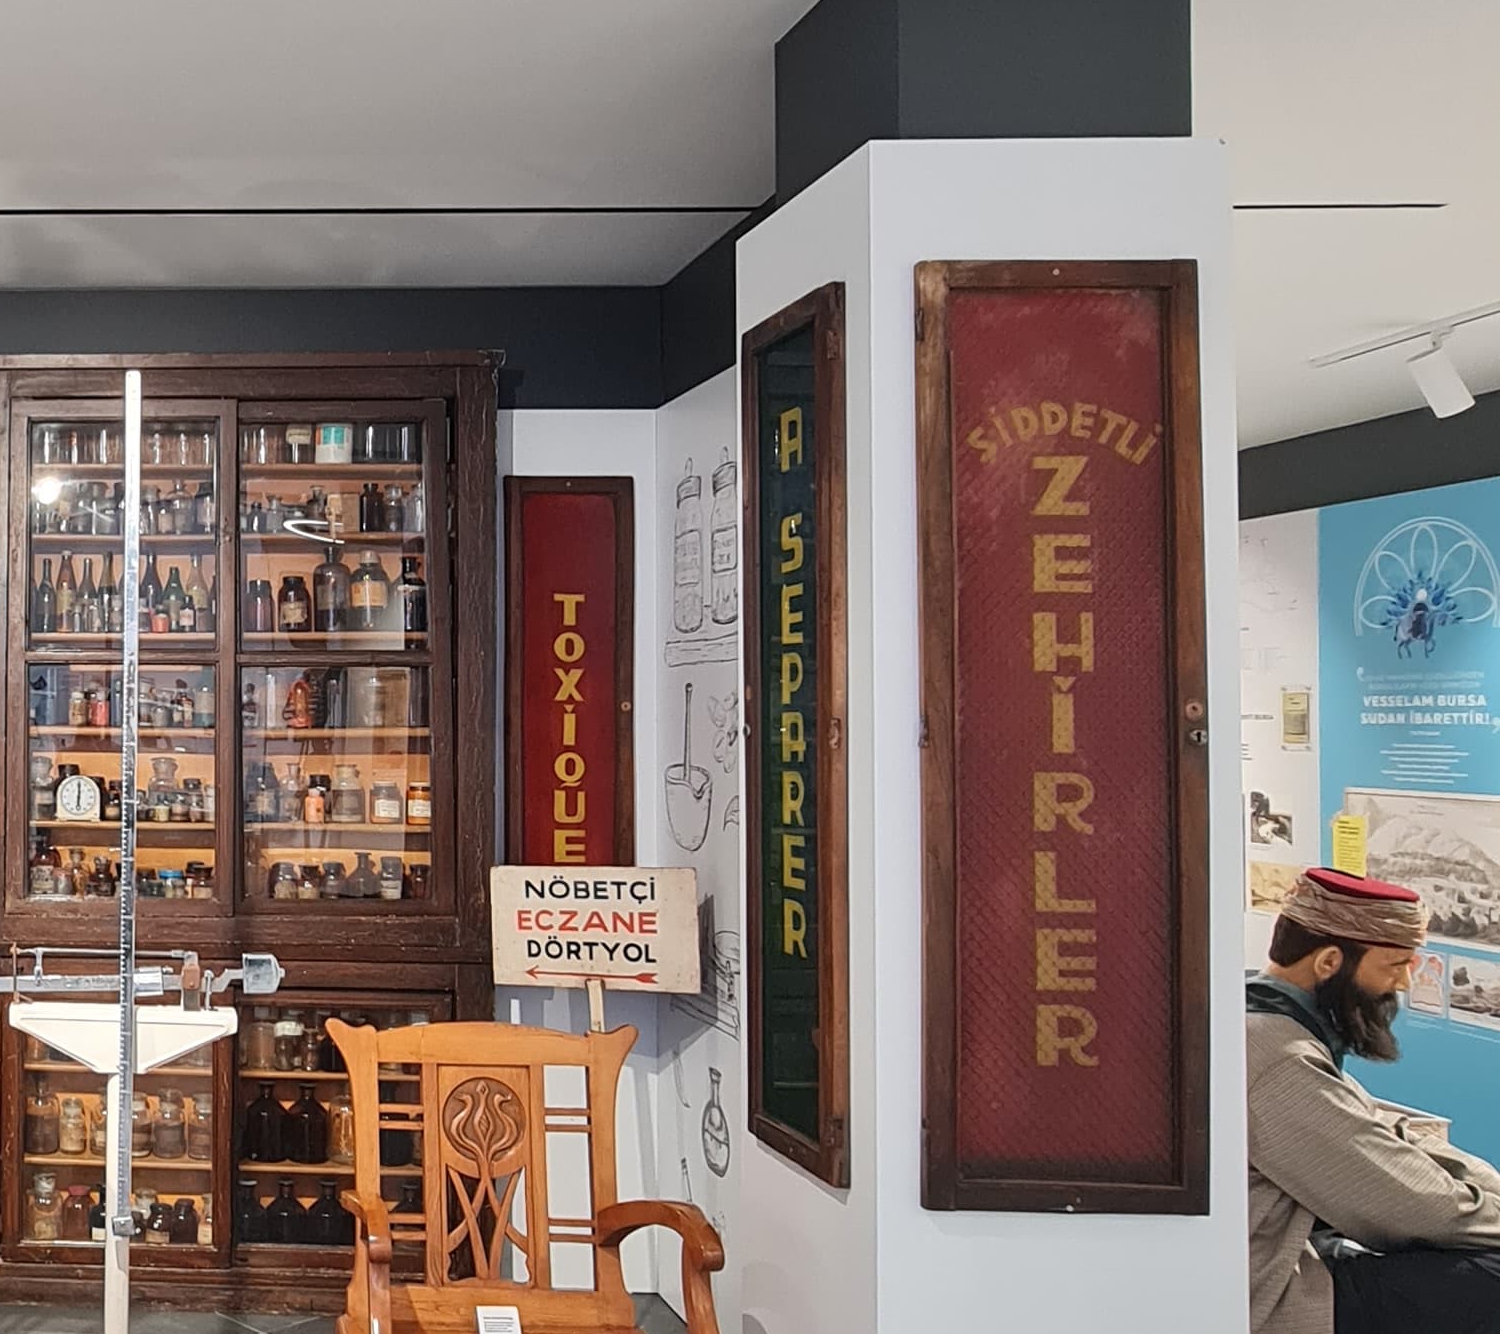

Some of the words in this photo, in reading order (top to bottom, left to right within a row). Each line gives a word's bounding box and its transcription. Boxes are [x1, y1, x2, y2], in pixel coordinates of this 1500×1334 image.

[779, 406, 803, 473] A
[1363, 694, 1434, 707] VESSELAM
[1437, 694, 1487, 707] BURSA
[1360, 712, 1406, 724] SUDAN
[779, 514, 808, 960] SEPARER
[1031, 455, 1100, 1067] ZEHİRLER
[524, 875, 657, 906] NÖBETÇİ
[516, 908, 658, 935] ECZANE
[526, 936, 657, 964] DÖRTYOL
